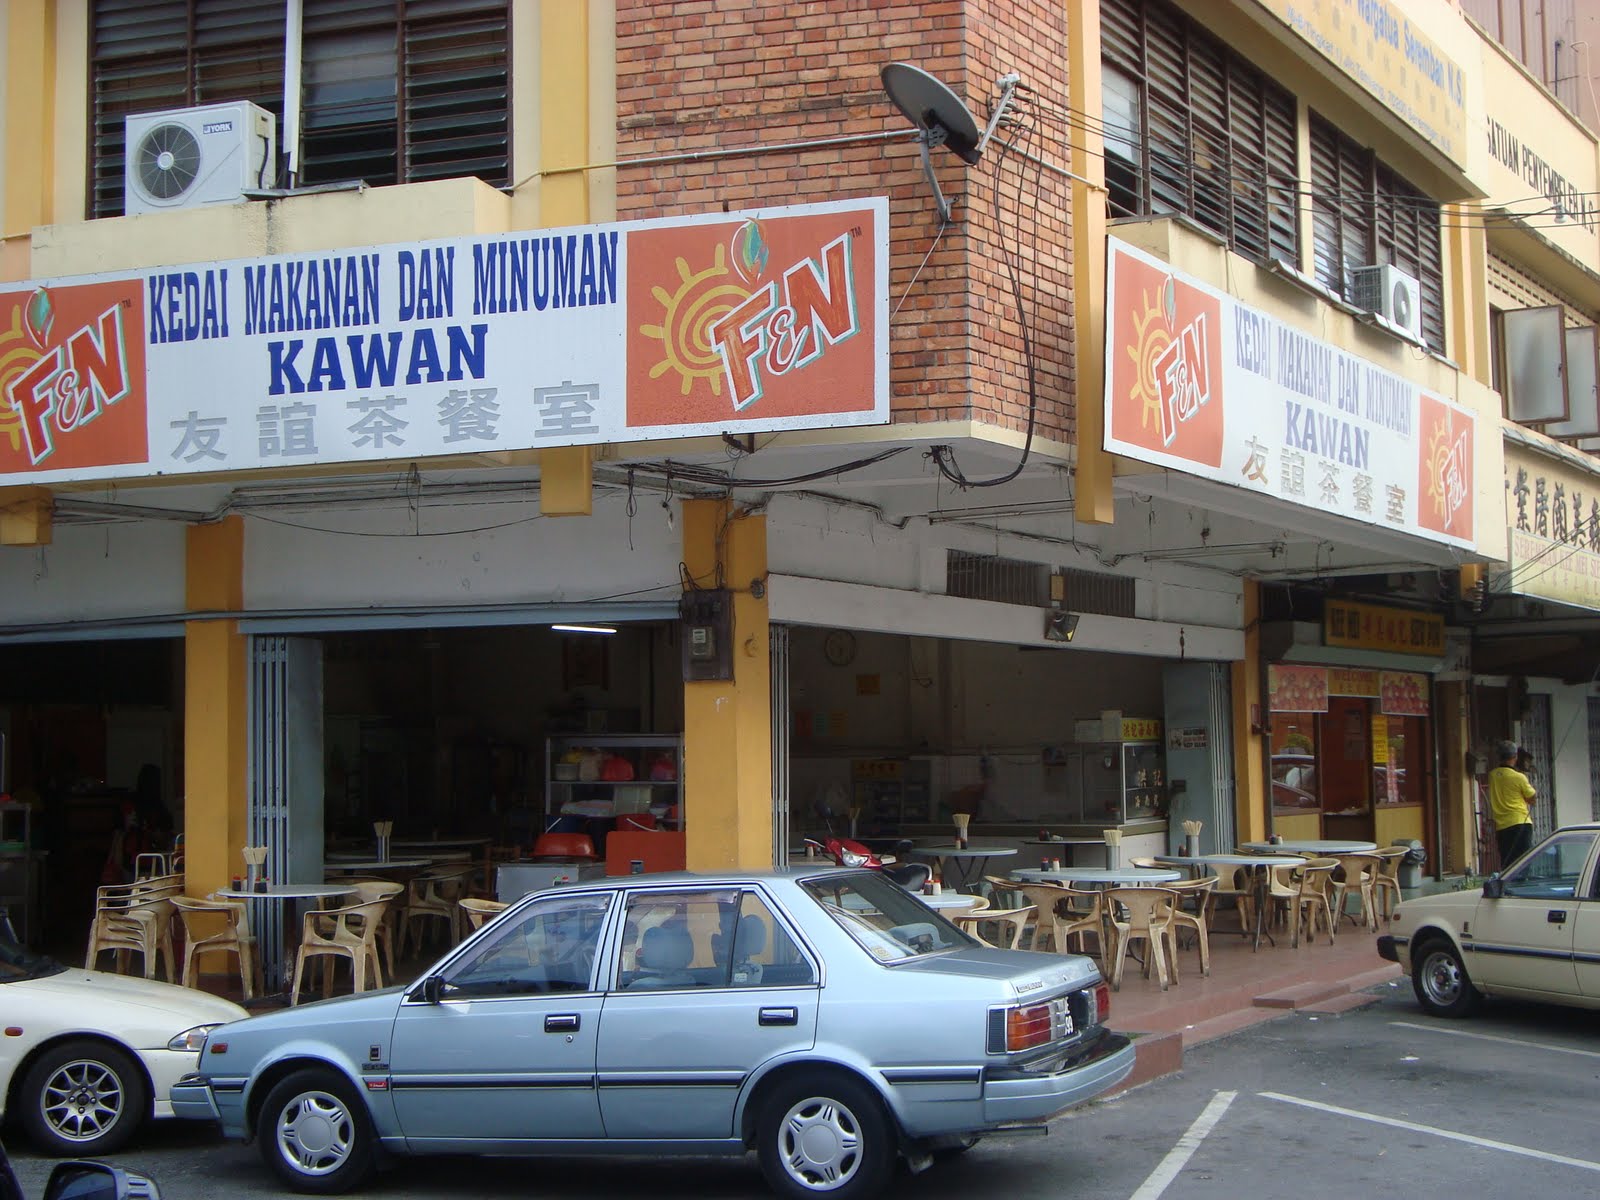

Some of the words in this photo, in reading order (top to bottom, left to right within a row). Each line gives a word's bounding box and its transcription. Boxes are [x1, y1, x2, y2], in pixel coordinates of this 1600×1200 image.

[210, 122, 231, 133] YORK
[149, 268, 230, 345] KEDAI
[244, 253, 382, 336] MAKANAN
[399, 246, 456, 323] DAN
[472, 231, 619, 316] MINUMAN
[709, 231, 861, 412] F&N
[8, 303, 132, 466] F&N
[267, 323, 489, 396] KAWAN
[1153, 310, 1211, 449] F&N
[1233, 304, 1272, 380] KEDAI
[1276, 326, 1333, 406] MAKANAN
[1337, 353, 1361, 417] DAN
[1365, 367, 1413, 441] MINUMAN
[169, 380, 601, 465] 友誼茶餐室
[1284, 400, 1371, 471] KAWAN
[1241, 434, 1407, 525] 友誼茶餐室
